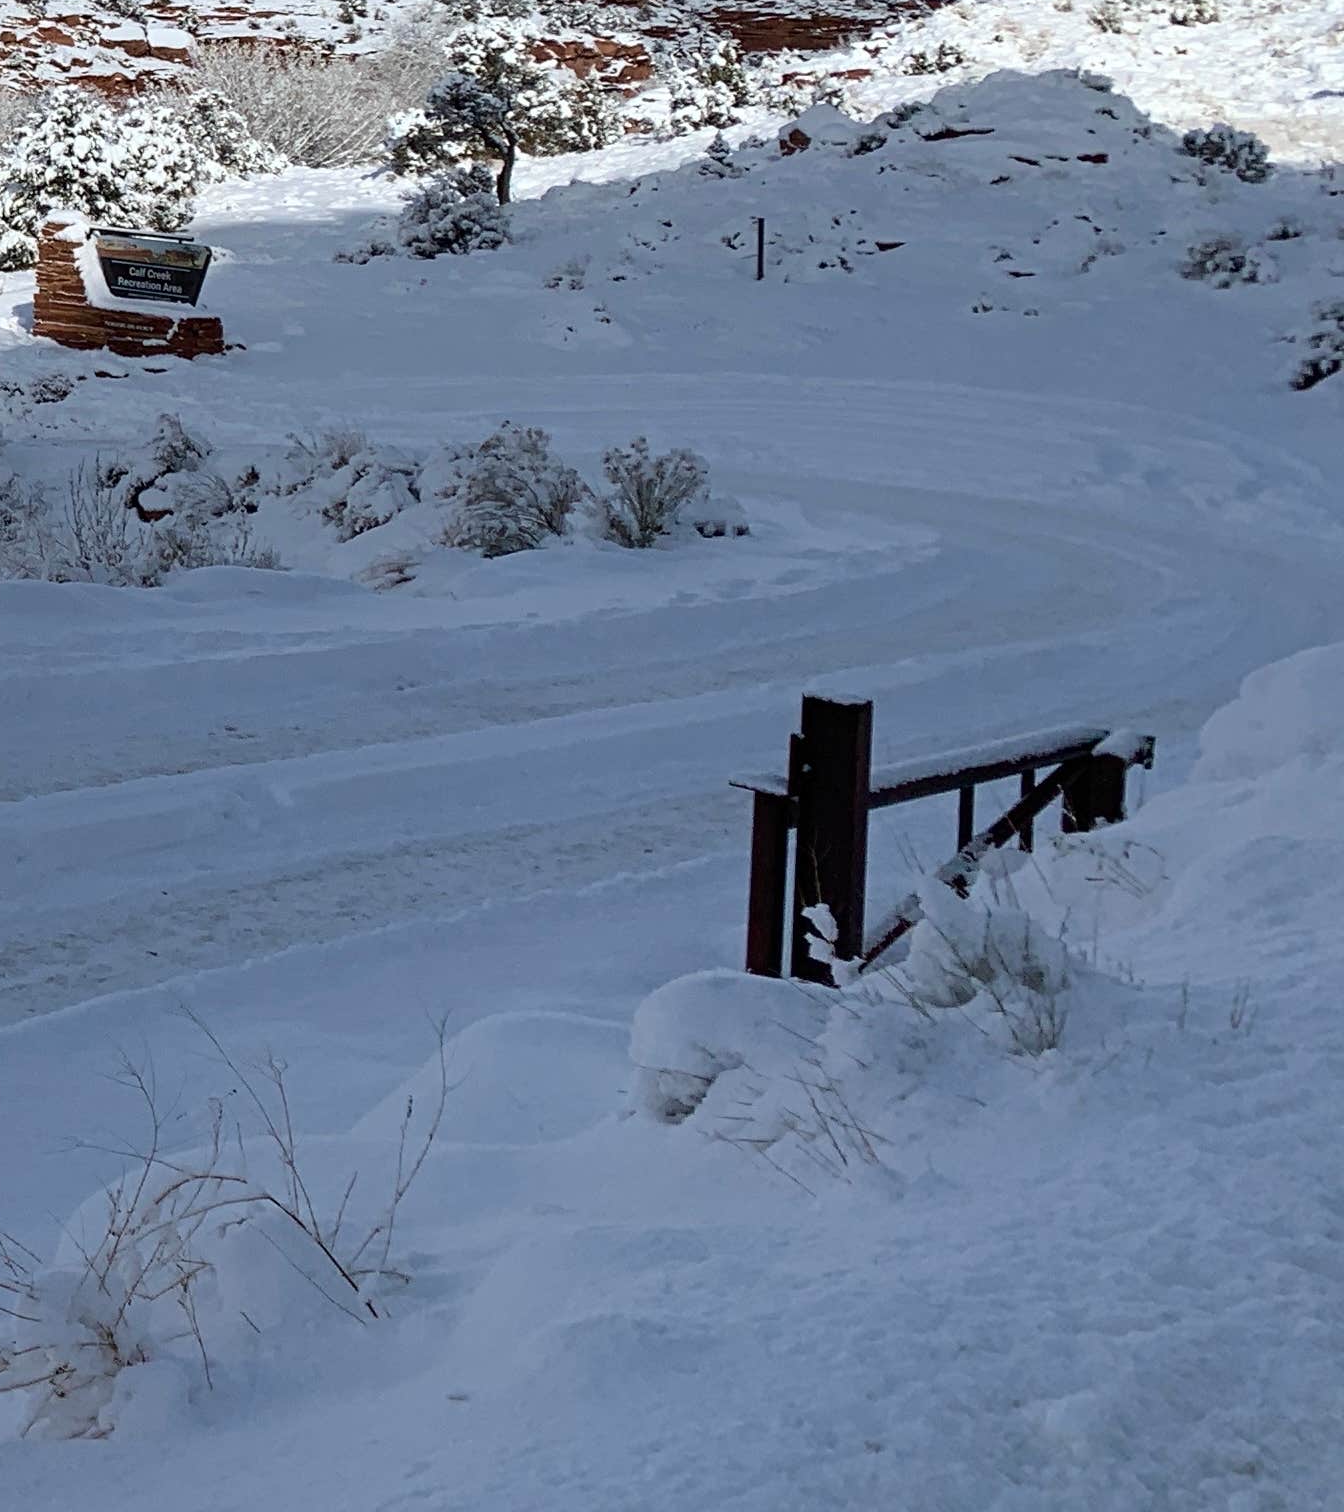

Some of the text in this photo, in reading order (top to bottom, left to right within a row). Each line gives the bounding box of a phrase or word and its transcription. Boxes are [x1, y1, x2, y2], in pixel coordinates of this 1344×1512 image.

[129, 267, 171, 280] Calf Creek
[118, 276, 183, 294] Recreation Area
